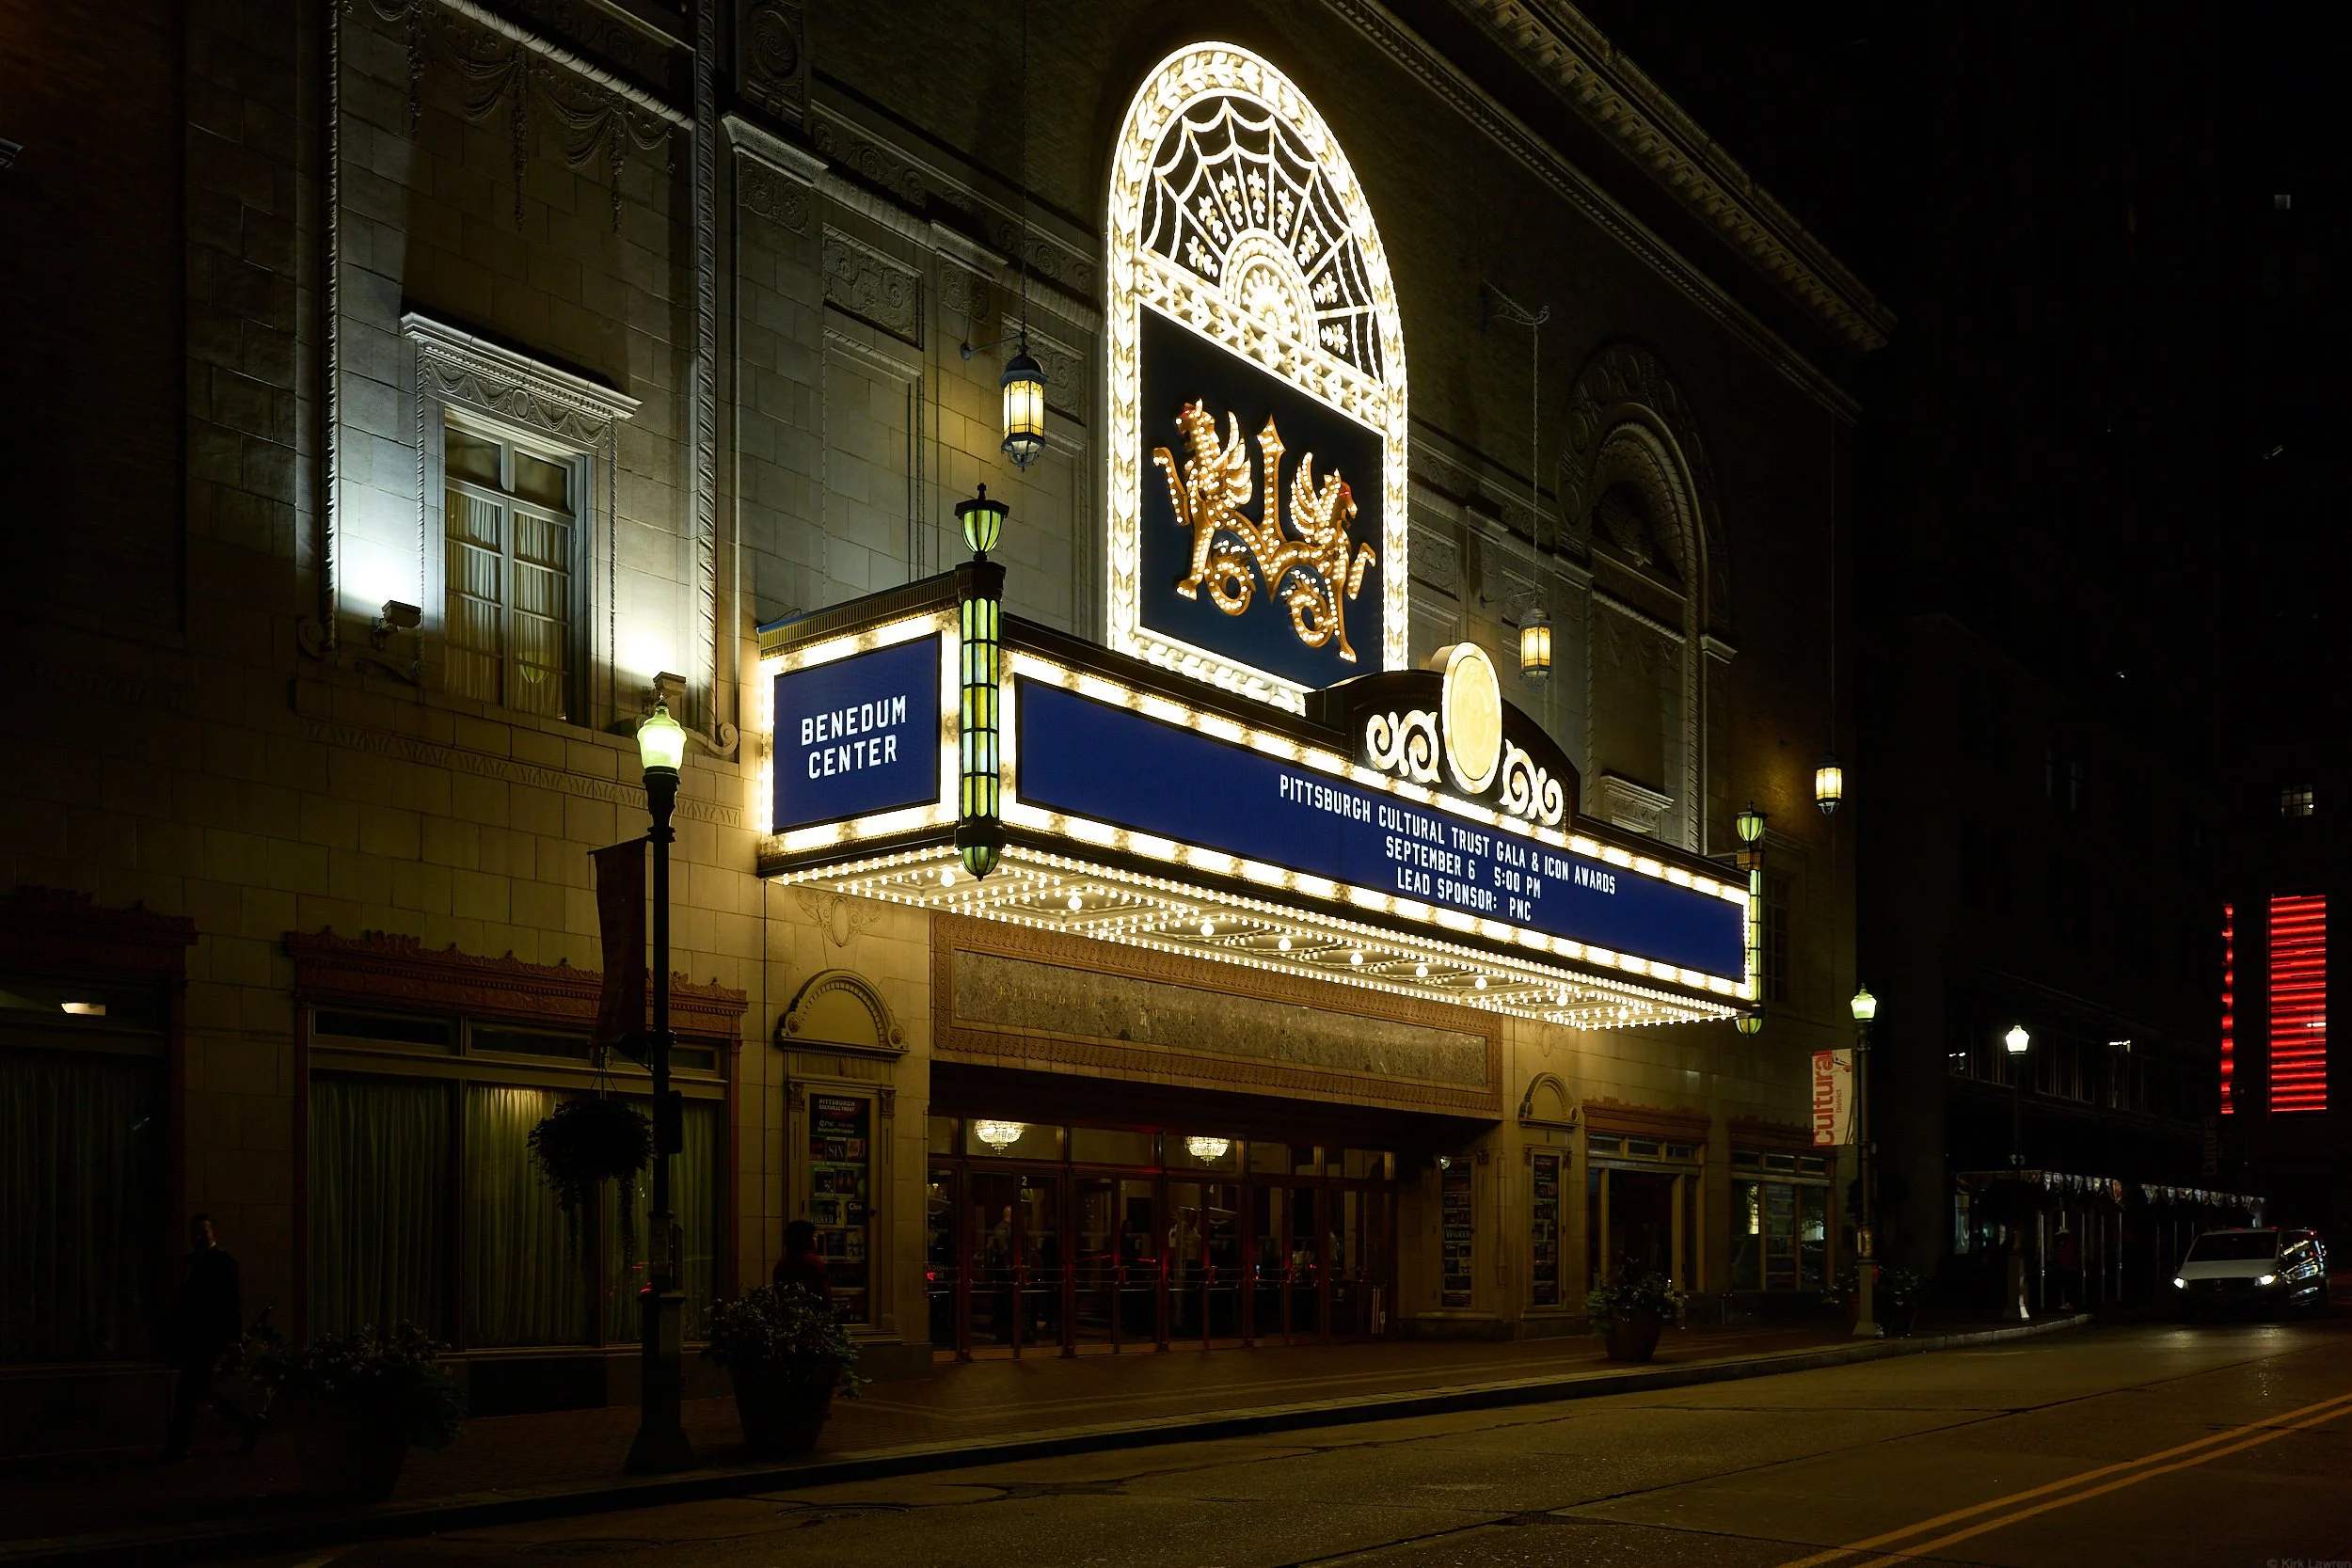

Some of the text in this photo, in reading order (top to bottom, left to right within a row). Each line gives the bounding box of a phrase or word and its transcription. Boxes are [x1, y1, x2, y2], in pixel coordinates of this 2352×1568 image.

[801, 694, 907, 747] BENEDUM
[808, 734, 898, 780] CENTER
[1279, 773, 1616, 895] PITTSBURGH CULTURAL TRUST GALA & ICON AWARDS
[1386, 835, 1541, 899] SEPTEMBER 6 5:00 PM
[1397, 866, 1532, 922] LEAD SPONSOR: PNC
[818, 1098, 855, 1107] PITTSBURGH
[828, 1144, 844, 1158] SIX
[1022, 1176, 1027, 1186] 2
[1209, 1184, 1215, 1195] 4
[849, 1202, 863, 1212] Clue
